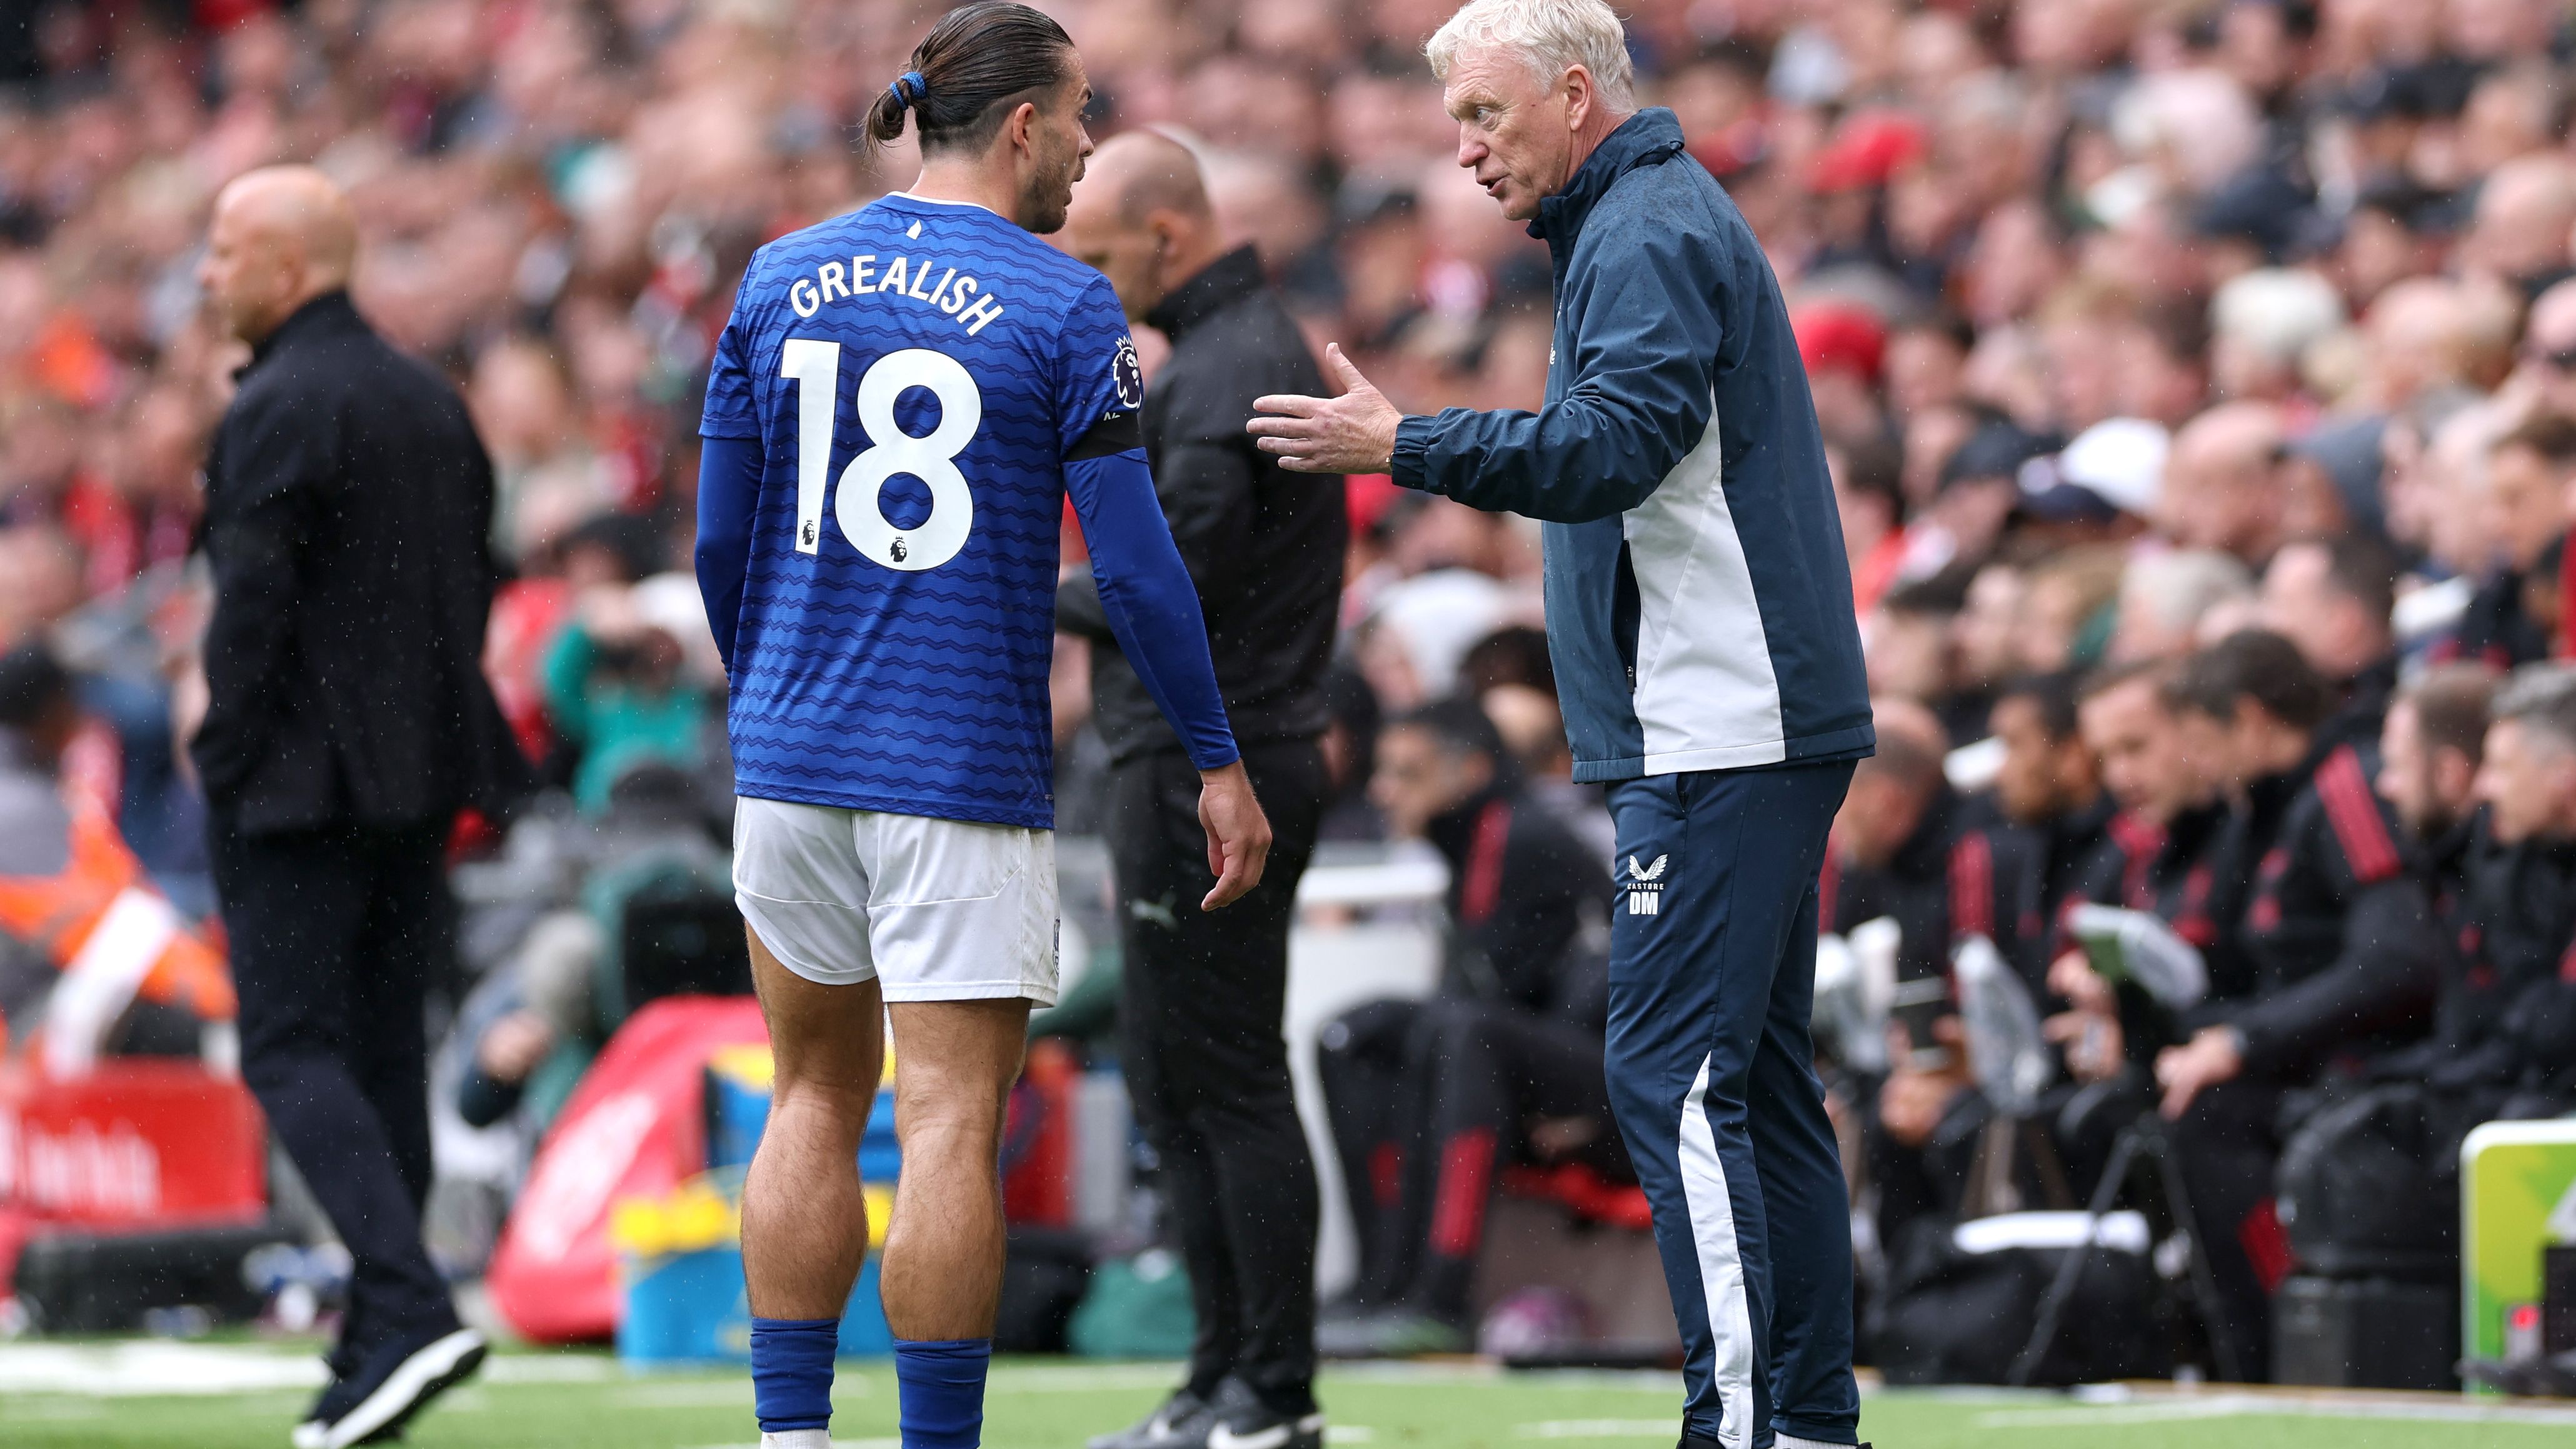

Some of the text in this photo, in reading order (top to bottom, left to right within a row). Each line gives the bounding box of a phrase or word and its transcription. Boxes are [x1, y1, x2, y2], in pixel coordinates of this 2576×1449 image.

[789, 254, 1004, 336] GREALISH
[780, 338, 982, 571] 18
[1629, 891, 1658, 915] DM
